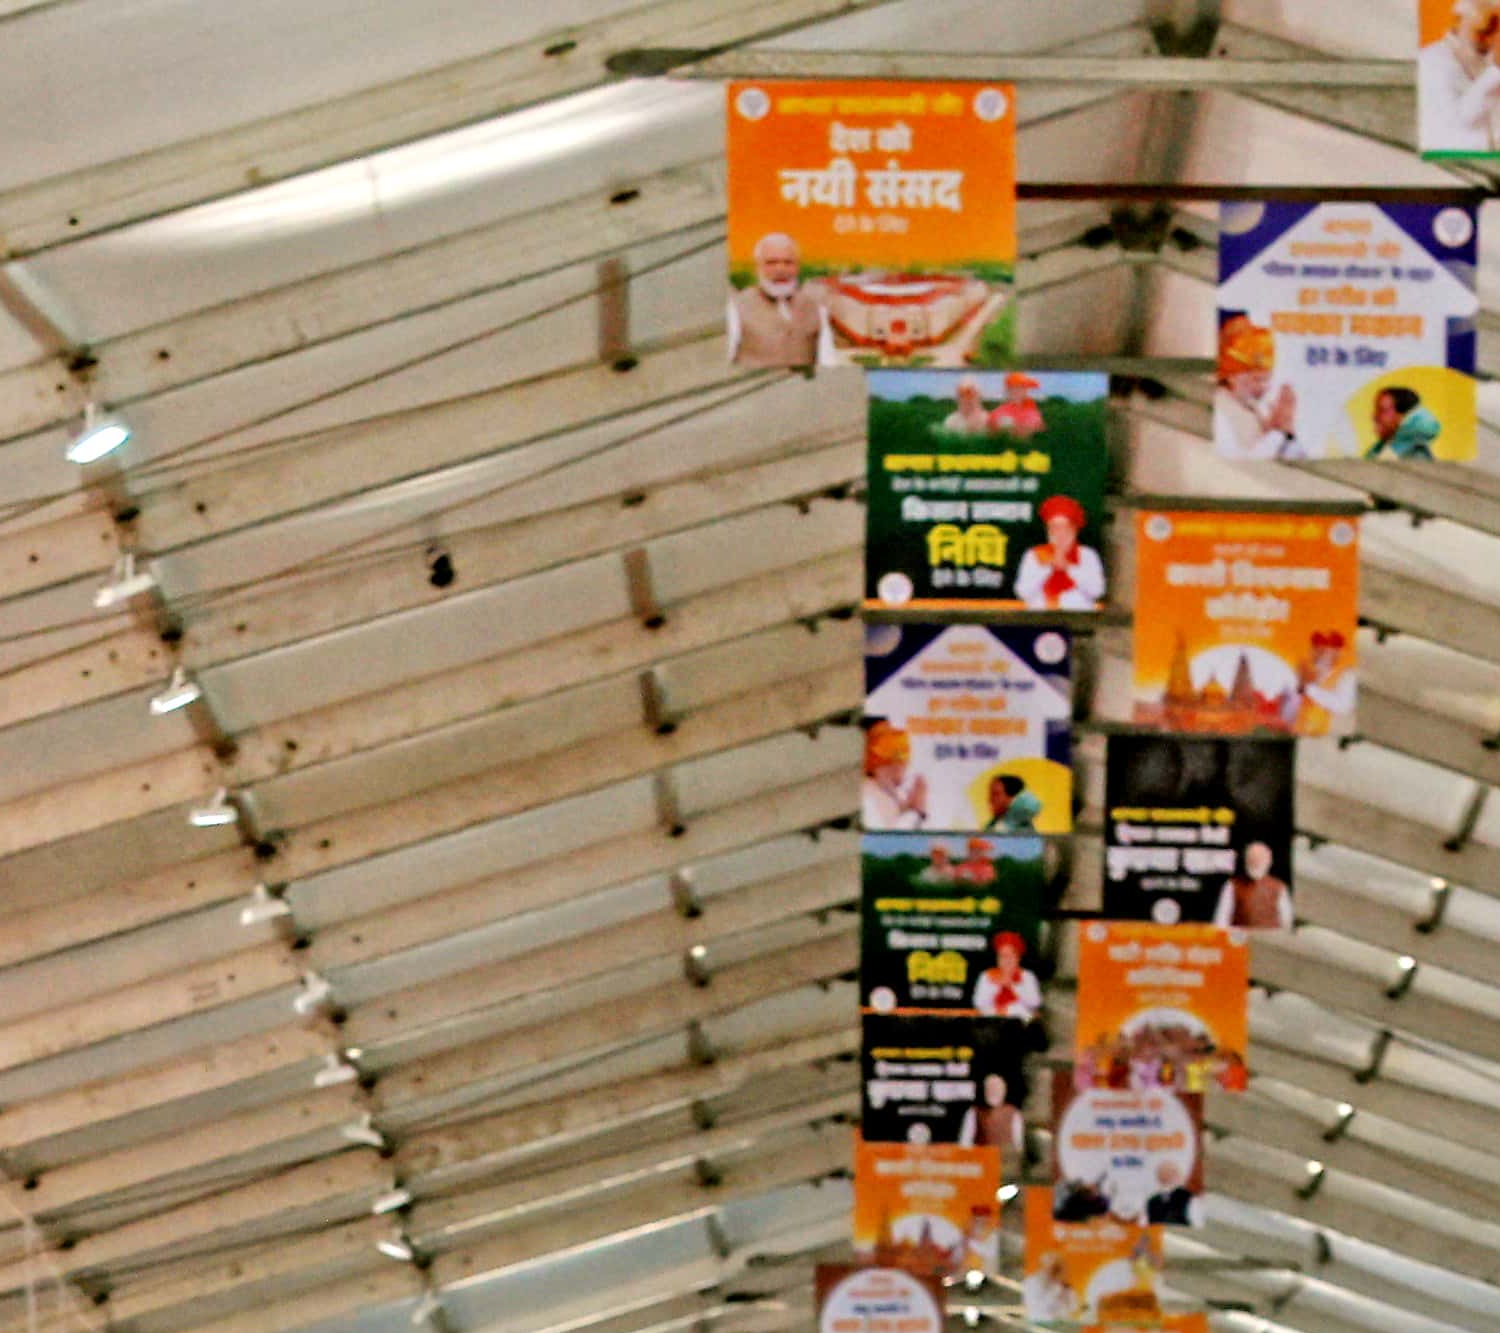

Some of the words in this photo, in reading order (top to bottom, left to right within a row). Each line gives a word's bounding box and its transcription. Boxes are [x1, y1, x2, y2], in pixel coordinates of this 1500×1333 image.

[778, 156, 857, 208] नयी
[865, 158, 964, 212] संसद
[926, 523, 1008, 568] निधि
